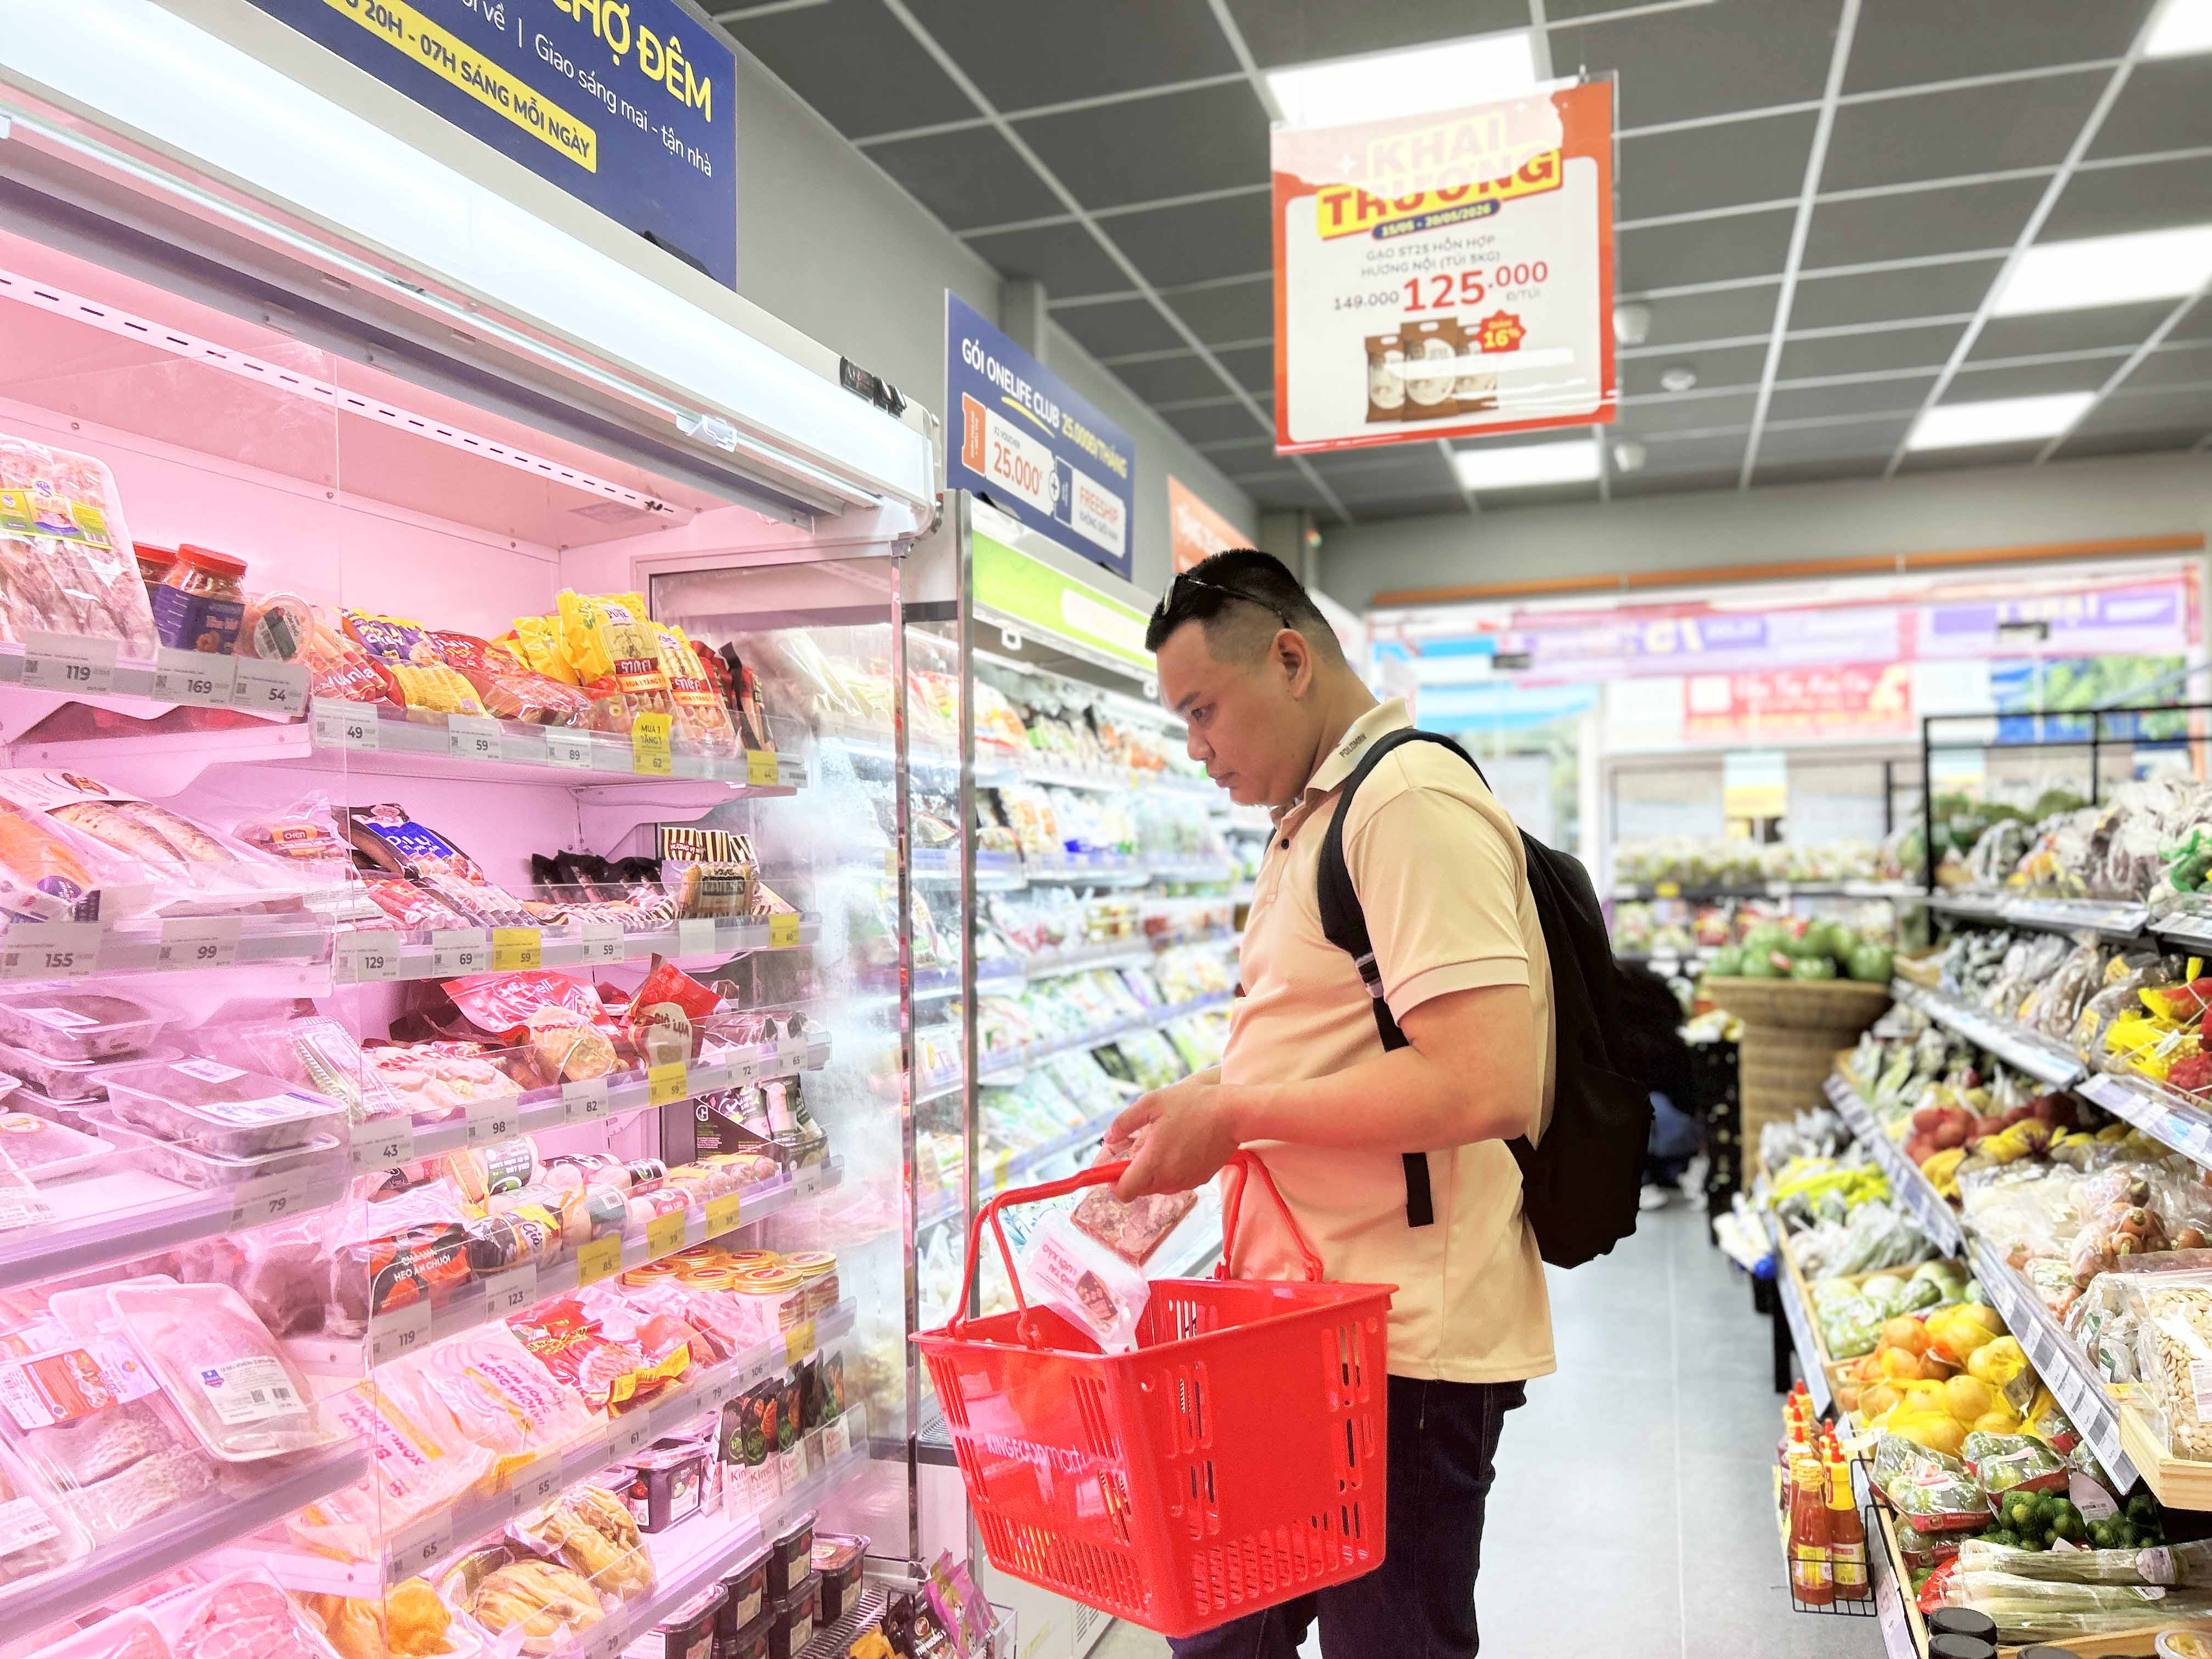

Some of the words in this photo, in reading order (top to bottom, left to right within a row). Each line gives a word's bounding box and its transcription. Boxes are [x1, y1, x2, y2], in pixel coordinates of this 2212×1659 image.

[364, 0, 403, 38] 20H
[420, 33, 456, 72] 07H
[460, 60, 509, 108] SÁNG
[514, 96, 545, 133] MỖI
[549, 119, 591, 159] NGÀY
[636, 25, 712, 123] ĐÊM
[535, 33, 574, 79] Giao
[578, 70, 617, 113] sáng
[621, 99, 648, 132] mai
[661, 124, 684, 157] tận
[687, 143, 713, 178] nhà
[1372, 116, 1502, 178] KHAI
[1334, 290, 1399, 311] 149.000
[1483, 328, 1521, 349] 16%
[962, 337, 984, 374] GÓI
[987, 357, 1031, 409] ONELIFE
[1034, 392, 1060, 428] CLUB
[66, 665, 91, 681] 119
[187, 679, 213, 694] 169
[269, 687, 287, 702] 54
[347, 726, 363, 738] 49
[641, 725, 656, 733] MUA
[476, 740, 488, 751] 59
[569, 750, 580, 761] 89
[653, 758, 662, 768] 62
[196, 946, 218, 960] 99
[520, 952, 532, 963] 59
[603, 945, 614, 956] 59
[45, 952, 74, 968] 155
[365, 956, 385, 969] 129
[459, 953, 473, 965] 69
[792, 1057, 800, 1065] 65
[743, 1066, 752, 1076] 72
[585, 1101, 597, 1112] 82
[492, 1121, 506, 1135] 98
[383, 1144, 398, 1158] 43
[268, 1197, 287, 1214] 79
[393, 1268, 413, 1282] HEO
[508, 1290, 524, 1307] 123
[399, 1330, 416, 1347] 119
[752, 1364, 763, 1378] 106
[713, 1387, 723, 1399] 79
[630, 1431, 640, 1444] 61
[538, 1481, 550, 1494] 55
[423, 1544, 438, 1560] 65
